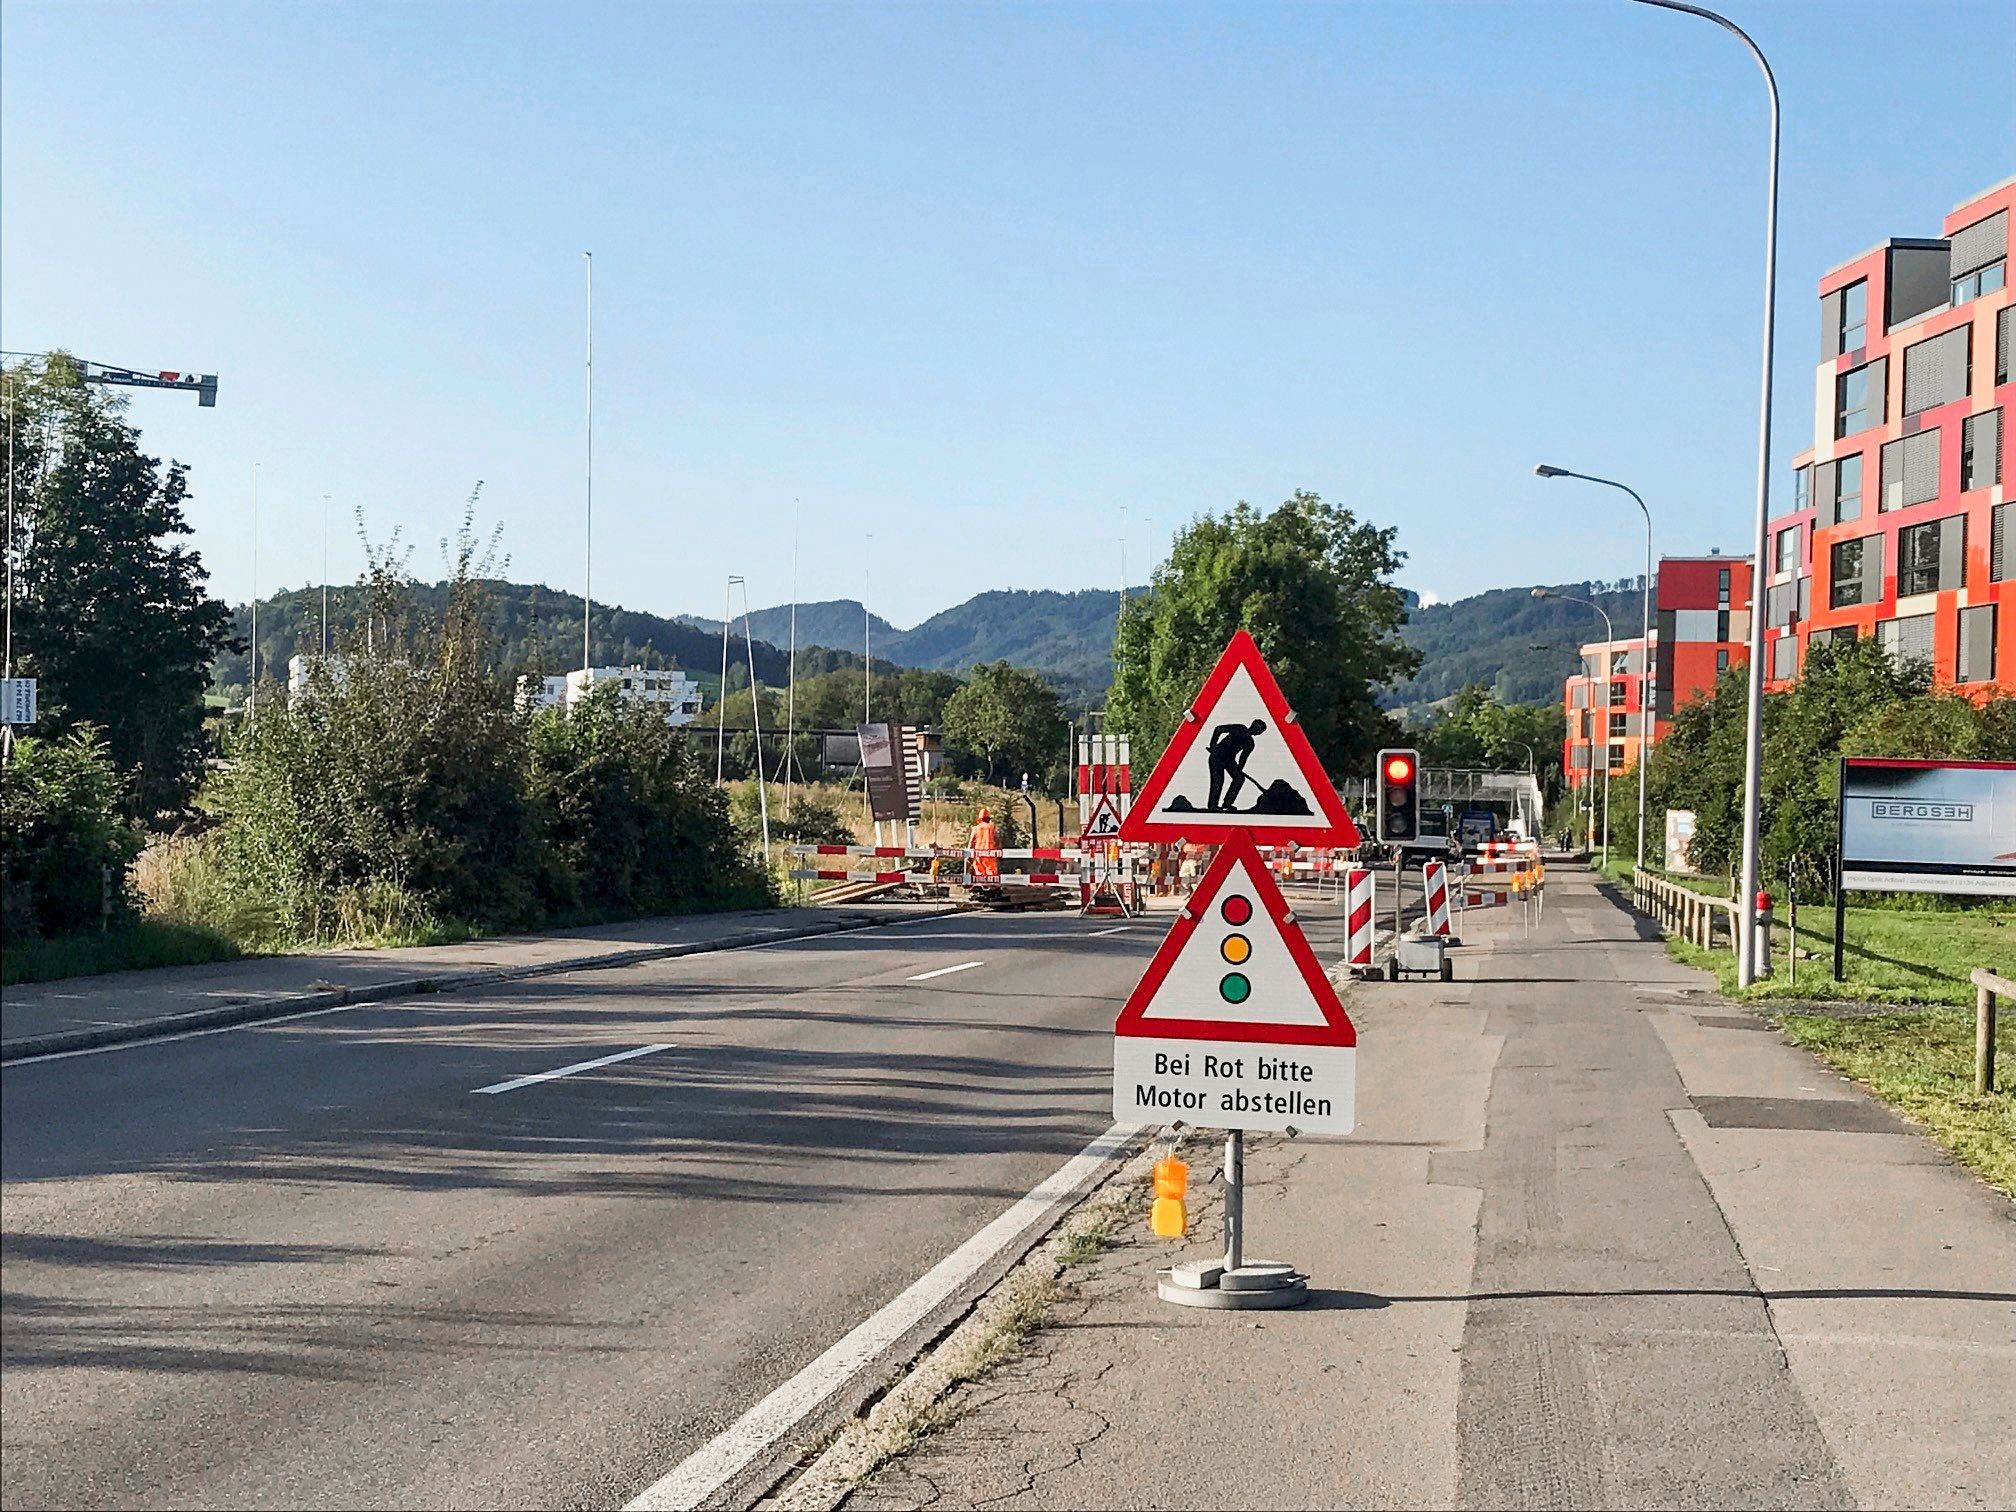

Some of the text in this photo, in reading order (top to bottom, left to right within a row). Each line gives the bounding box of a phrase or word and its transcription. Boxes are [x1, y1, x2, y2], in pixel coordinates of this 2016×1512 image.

[1155, 1053, 1313, 1082] Bei Rot bitte
[1136, 1085, 1331, 1116] Motor abstellen
